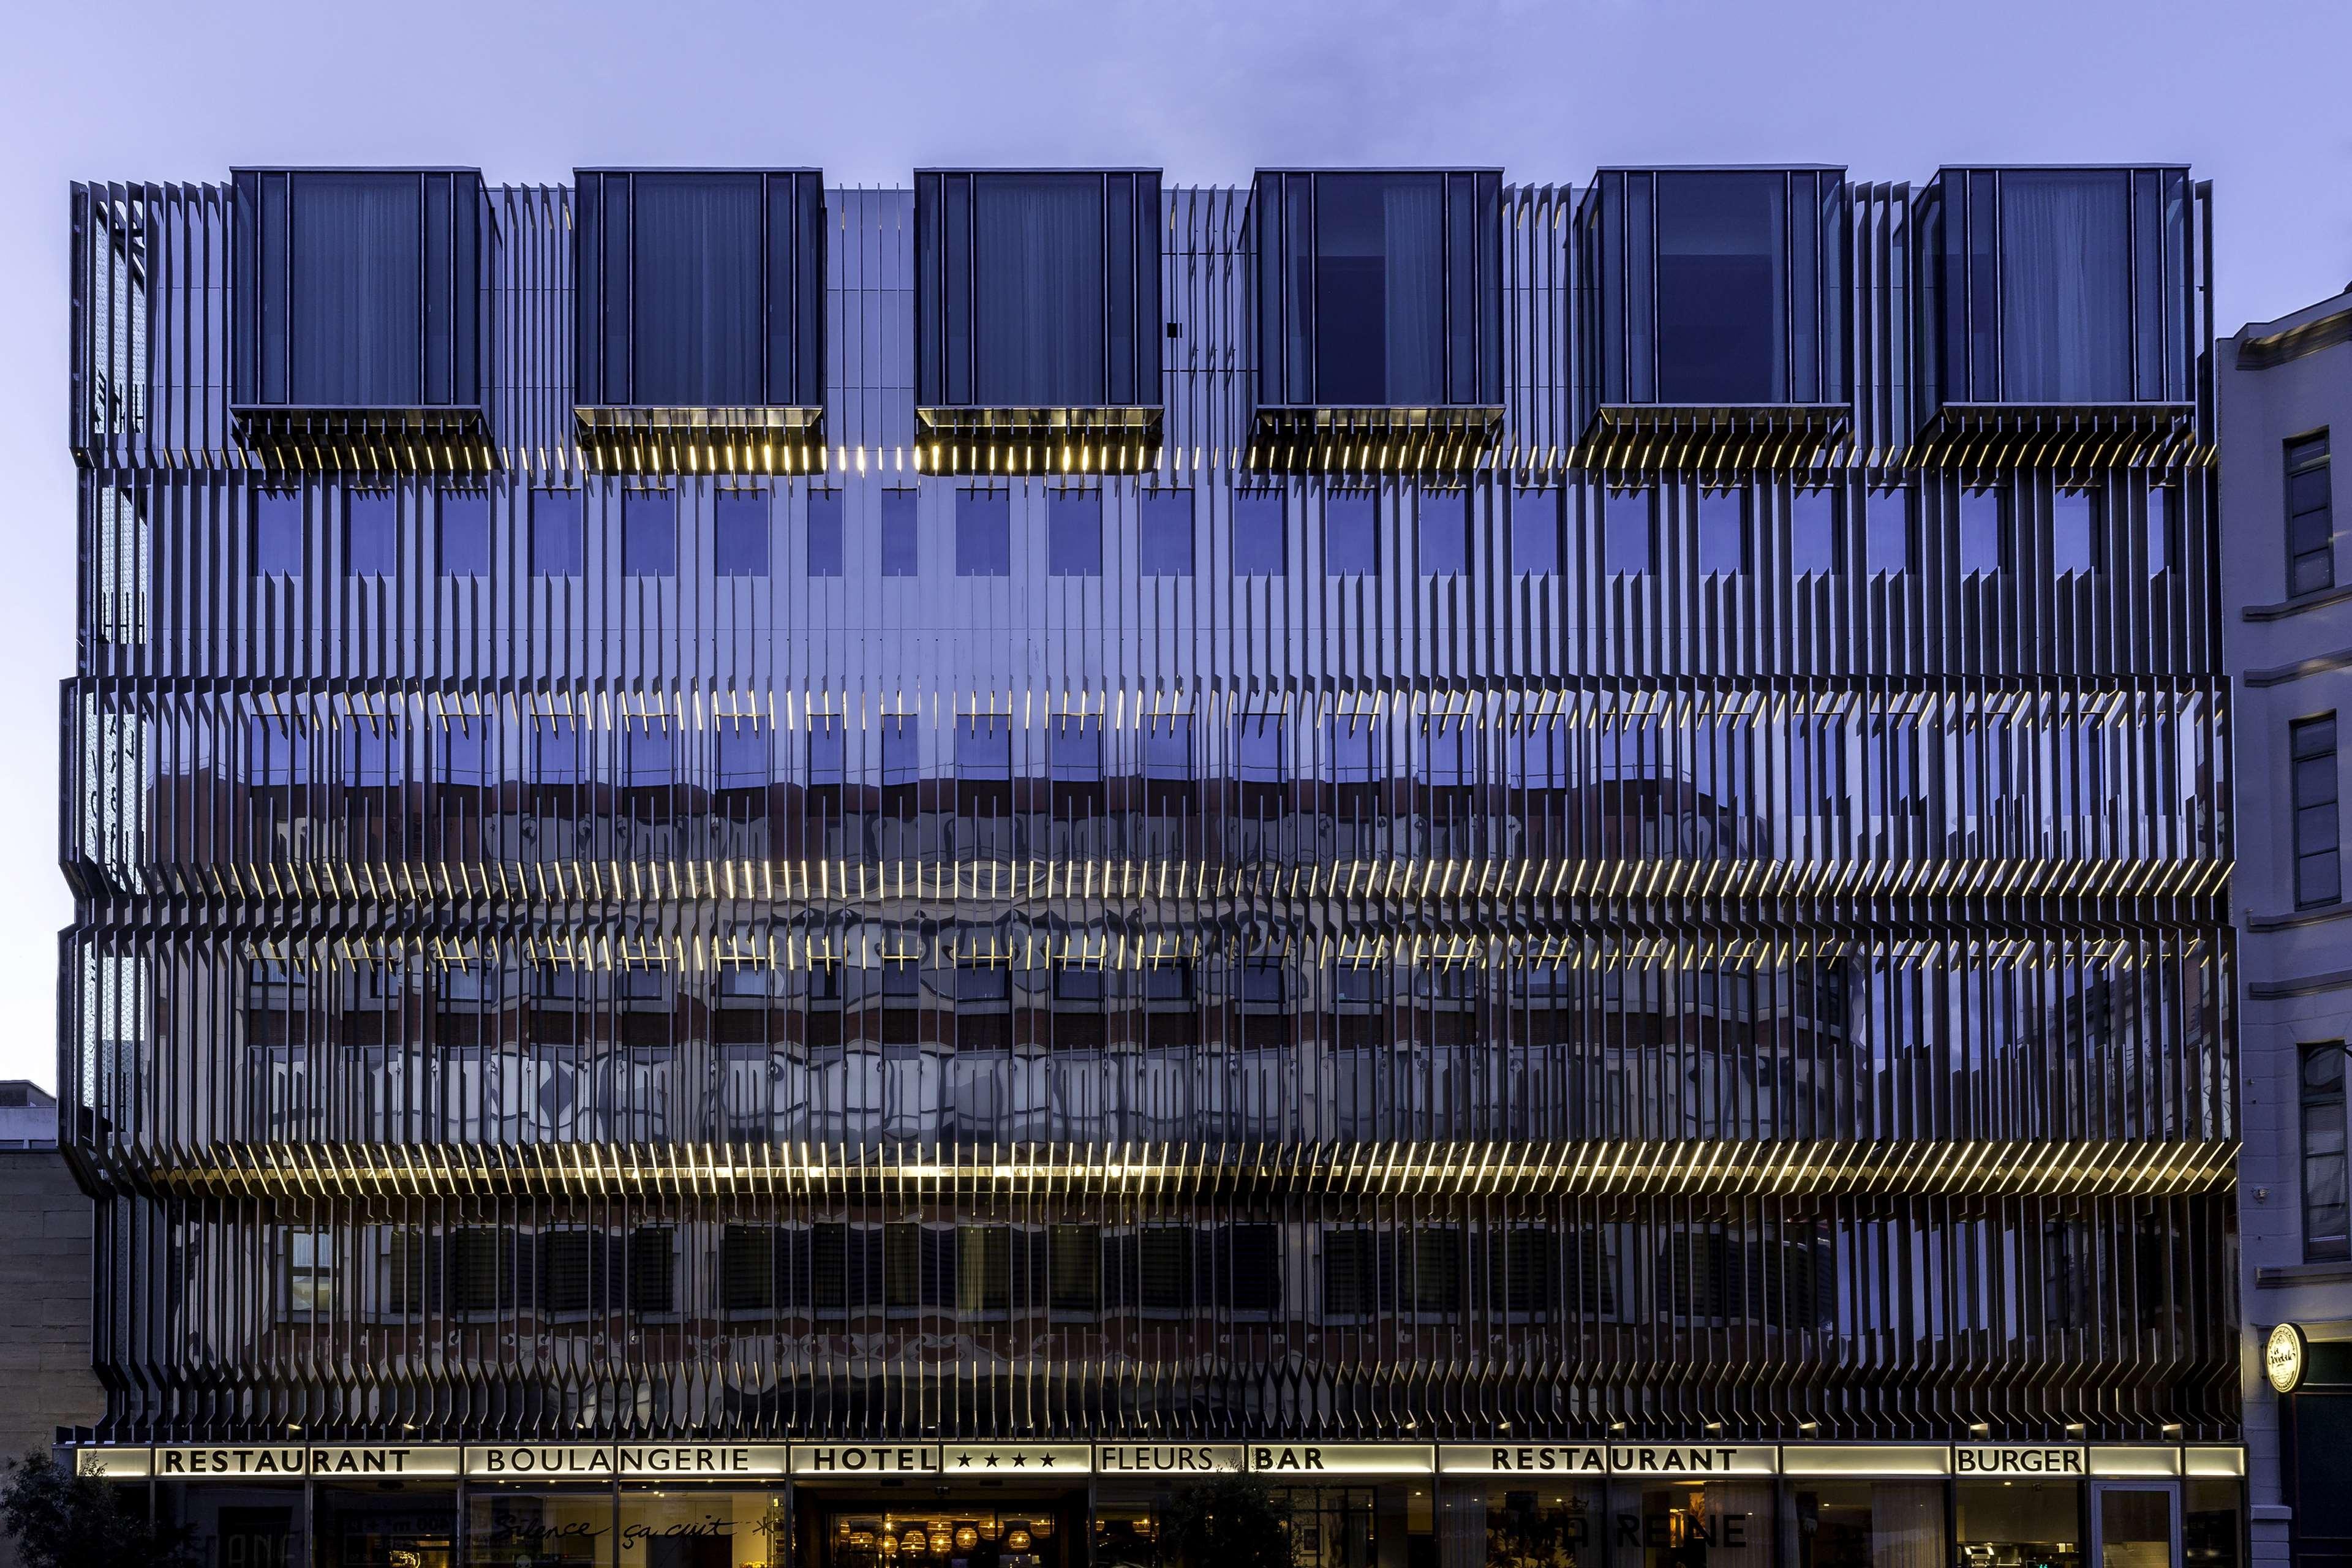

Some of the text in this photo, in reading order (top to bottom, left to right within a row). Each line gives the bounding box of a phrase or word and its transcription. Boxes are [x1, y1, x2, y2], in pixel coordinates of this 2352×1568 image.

[165, 1450, 410, 1472] RESTAURANT
[487, 1449, 748, 1471] BOULANGERIE
[814, 1447, 937, 1470] HOTEL
[1102, 1447, 1212, 1470] FLEURS
[1255, 1447, 1324, 1470] BAR
[1492, 1447, 1737, 1471] RESTAURANT
[1958, 1449, 2082, 1472] BURGER
[494, 1514, 737, 1549] Silence ça cuit
[1617, 1515, 1746, 1548] REINE
